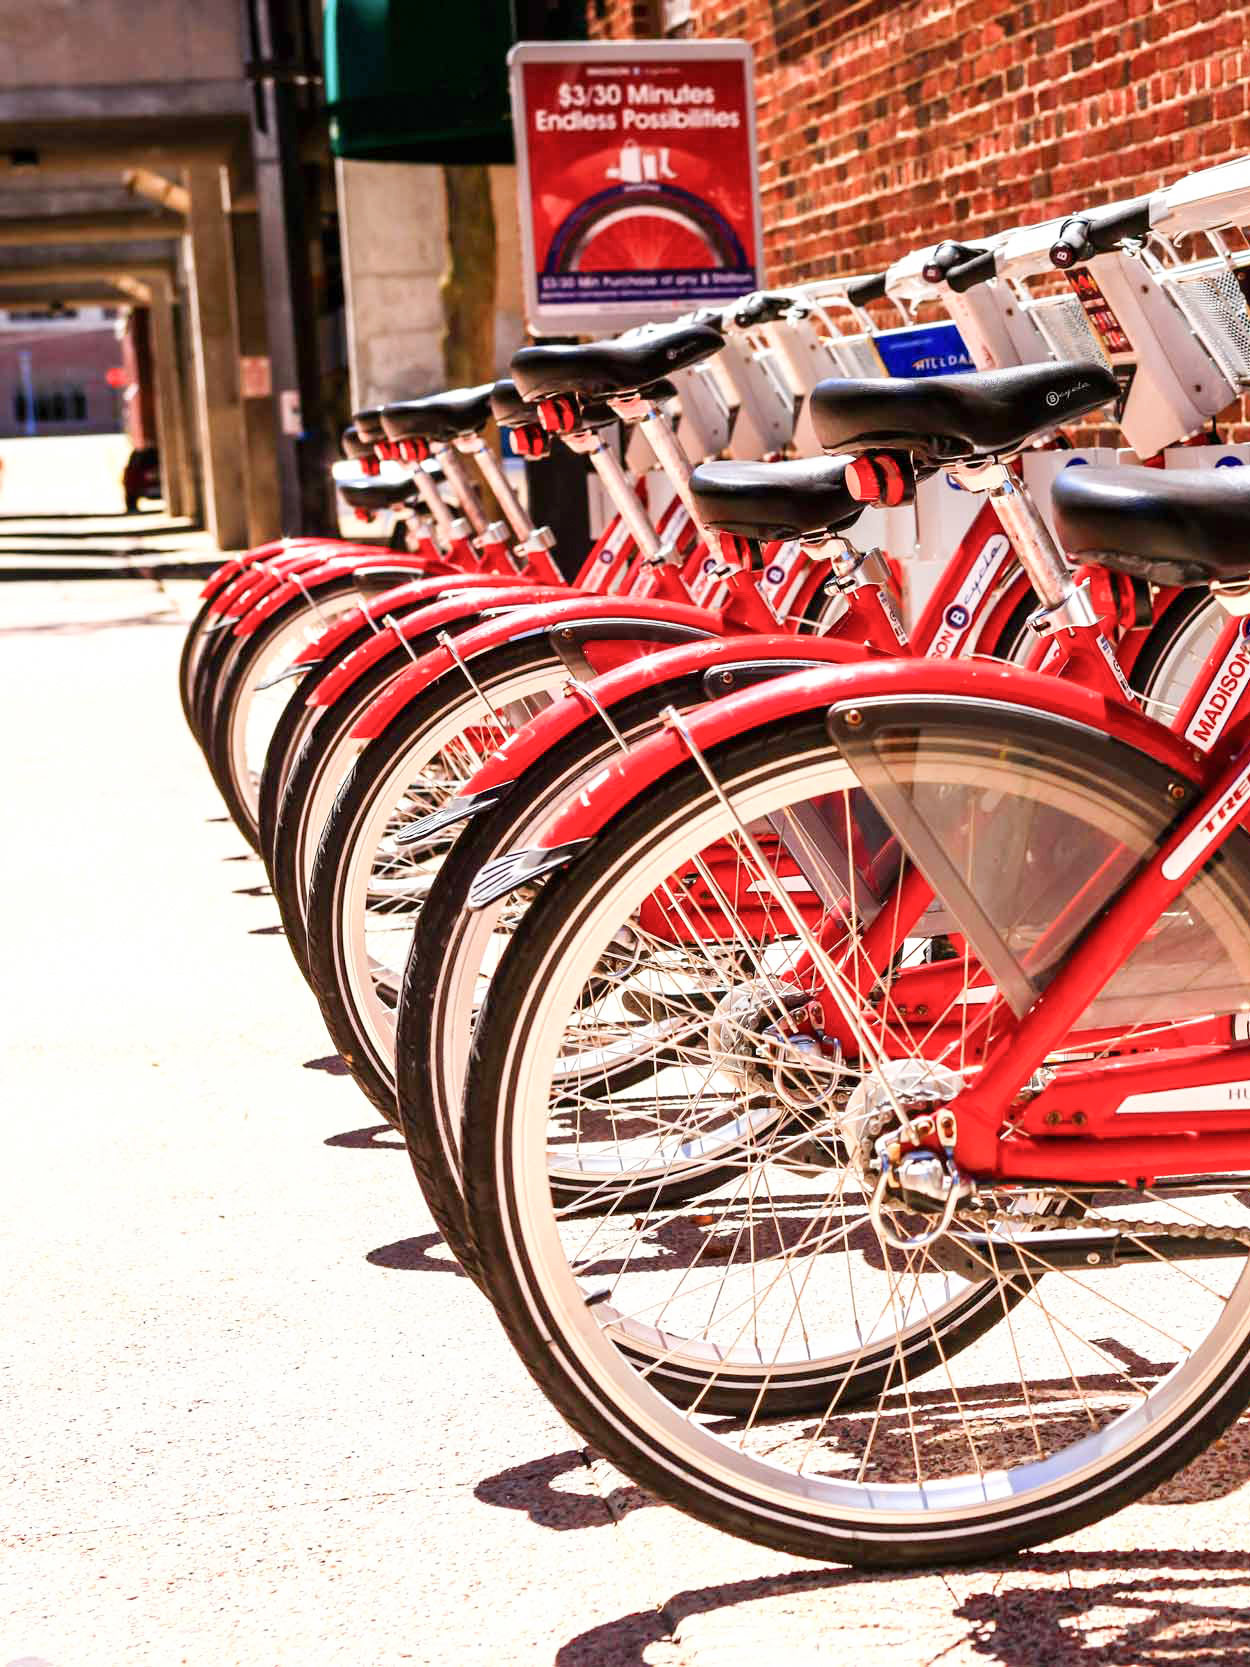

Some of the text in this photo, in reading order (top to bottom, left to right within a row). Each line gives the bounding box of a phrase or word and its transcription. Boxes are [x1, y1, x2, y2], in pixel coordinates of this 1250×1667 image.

[559, 83, 714, 107] $3/30 Minutes
[535, 108, 739, 131] Endless Possibilities
[950, 611, 965, 625] B
[1193, 650, 1250, 742] MADISON
